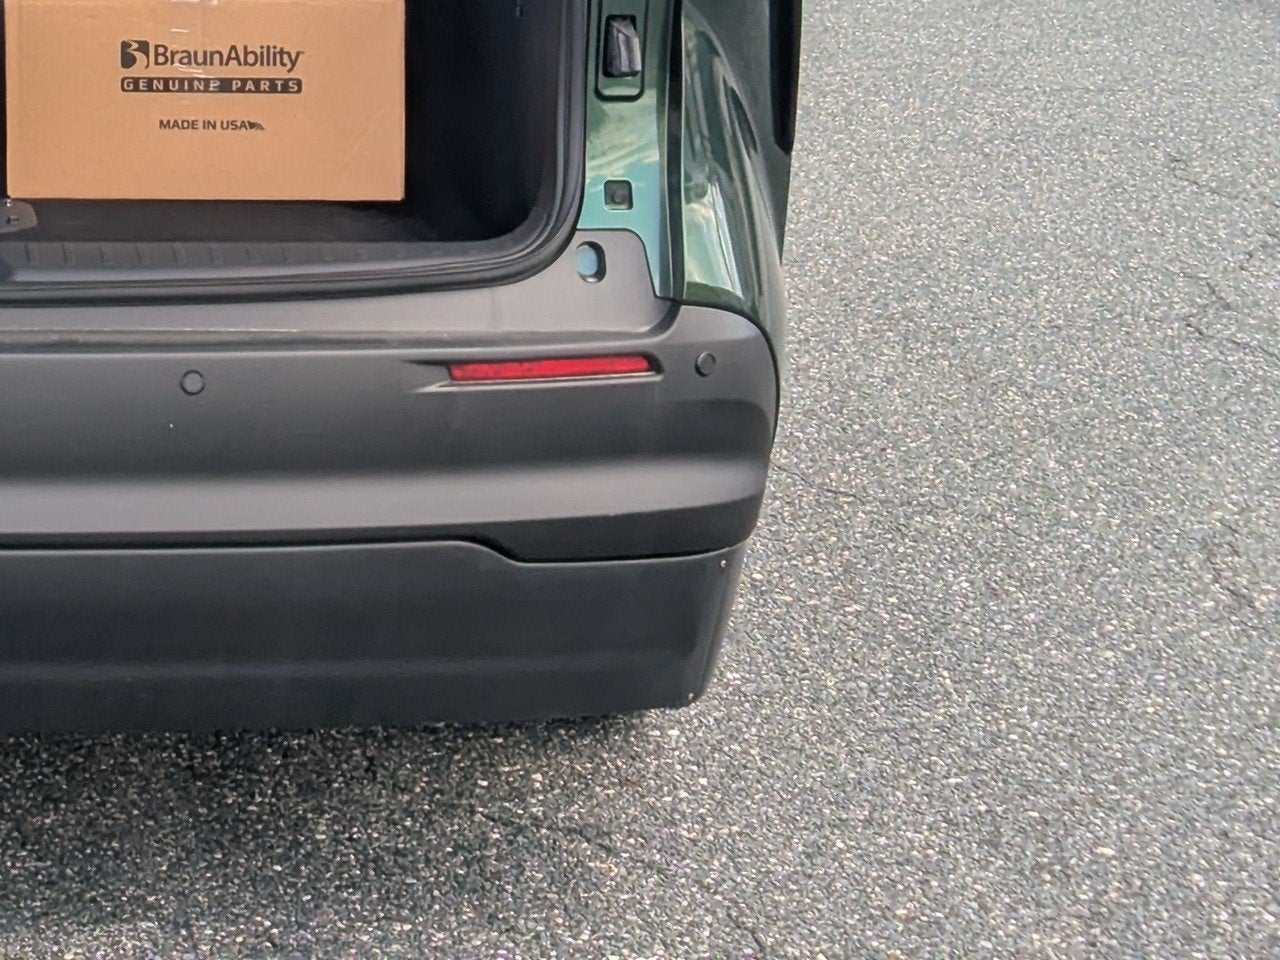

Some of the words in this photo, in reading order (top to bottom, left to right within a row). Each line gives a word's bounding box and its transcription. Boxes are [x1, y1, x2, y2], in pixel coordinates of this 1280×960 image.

[153, 43, 301, 73] BraunAbility
[123, 78, 220, 91] GENUINE
[231, 79, 299, 92] PARTS
[159, 119, 199, 130] MADE
[202, 120, 217, 130] IN
[220, 120, 248, 131] USA
